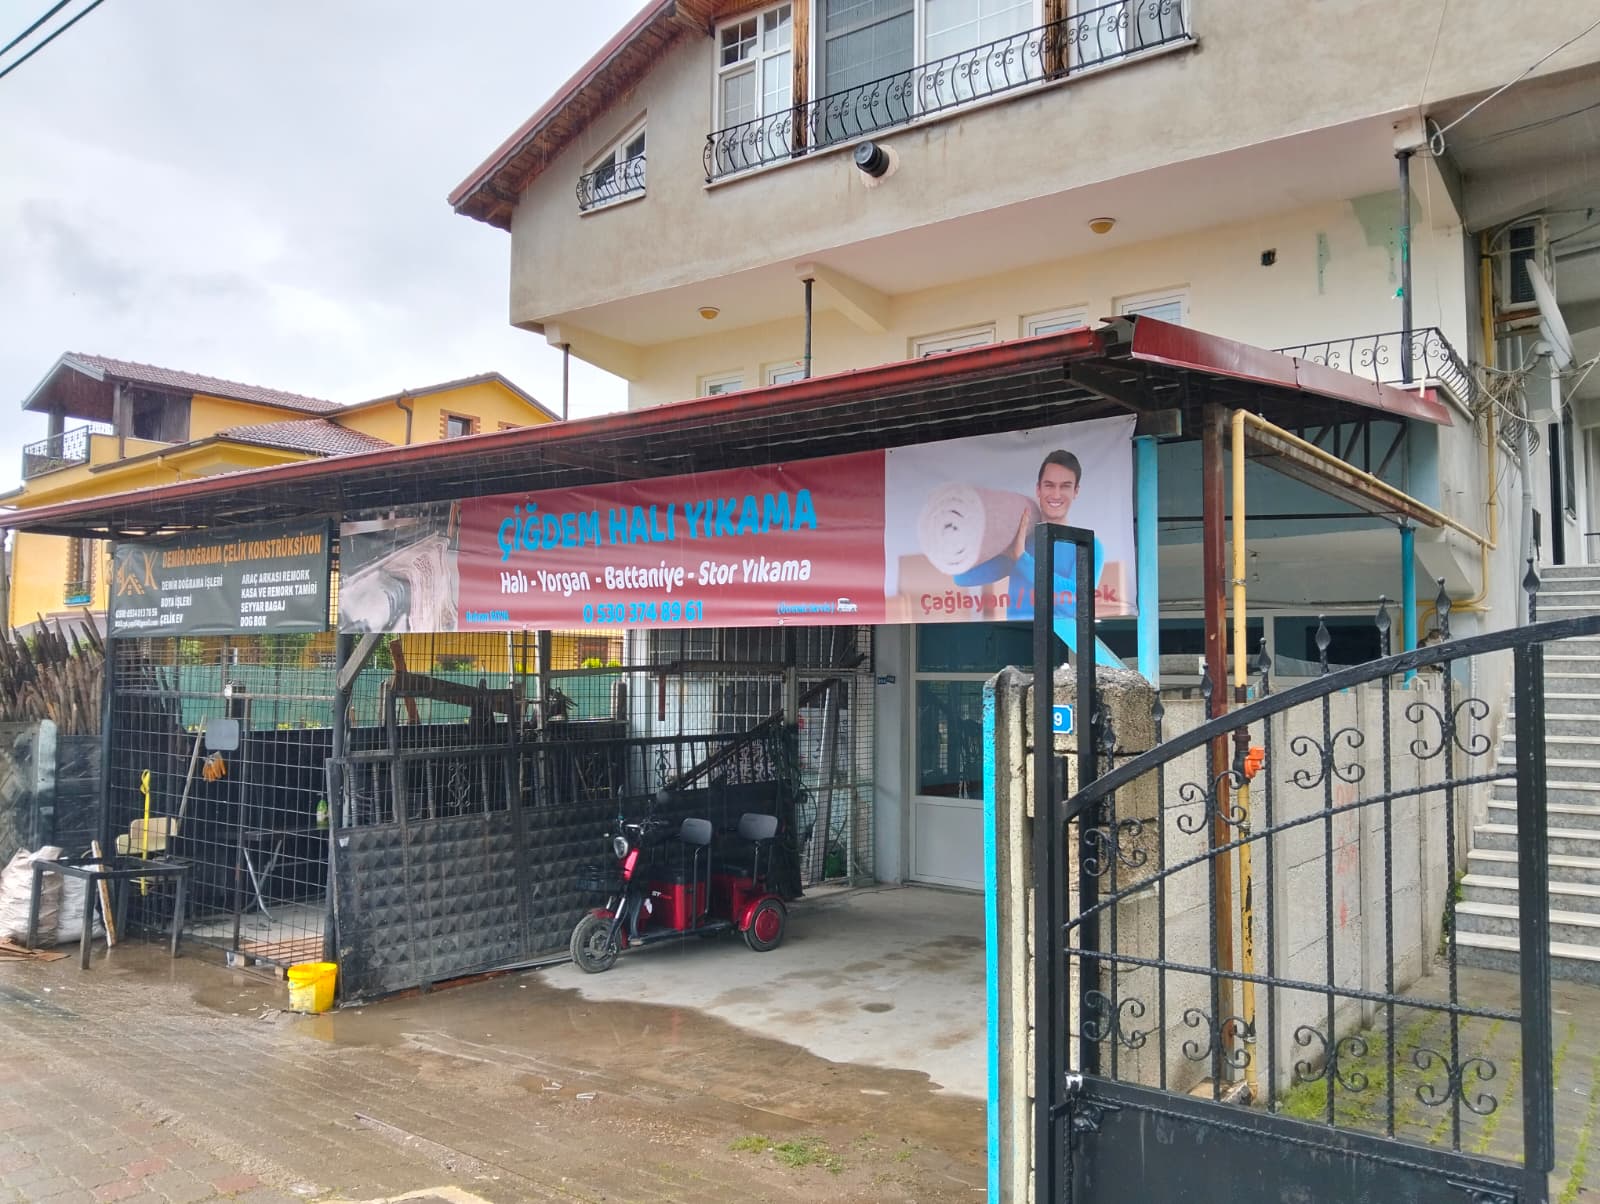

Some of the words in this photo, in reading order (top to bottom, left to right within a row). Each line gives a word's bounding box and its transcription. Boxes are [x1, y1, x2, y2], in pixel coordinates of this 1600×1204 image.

[498, 502, 602, 562] ÇİĞDEM
[608, 503, 675, 545] HALI
[684, 488, 817, 540] YIKAMA
[162, 546, 185, 568] DEMİR
[185, 543, 221, 566] DOĞRAMA
[223, 539, 247, 567] ÇELİK
[248, 532, 321, 560] KONSTRÜKSİYON
[161, 577, 178, 590] DEMİR
[204, 573, 223, 590] İŞLERİ
[241, 573, 258, 586] ARAÇ
[259, 571, 282, 583] ARKASI
[282, 569, 310, 582] REMORK
[501, 570, 528, 594] Halı
[537, 569, 590, 597] Yorgan
[604, 561, 685, 593] Battaniye
[698, 561, 738, 586] Stor
[742, 556, 812, 584] Yıkama
[241, 587, 258, 599] KASA
[258, 586, 266, 598] VE
[267, 585, 294, 597] REMORK
[294, 581, 318, 596] TAMİRİ
[240, 601, 264, 613] SEYYAR
[264, 599, 286, 612] BAGAJ
[583, 603, 593, 624] 0
[597, 602, 625, 623] 530
[628, 601, 657, 623] 374
[660, 600, 681, 622] 89
[685, 599, 703, 622] 61
[921, 590, 1011, 615] Çağlayan
[160, 611, 176, 626] ÇELİK
[176, 613, 184, 624] EV
[240, 615, 253, 627] DOG
[253, 615, 267, 626] BOX
